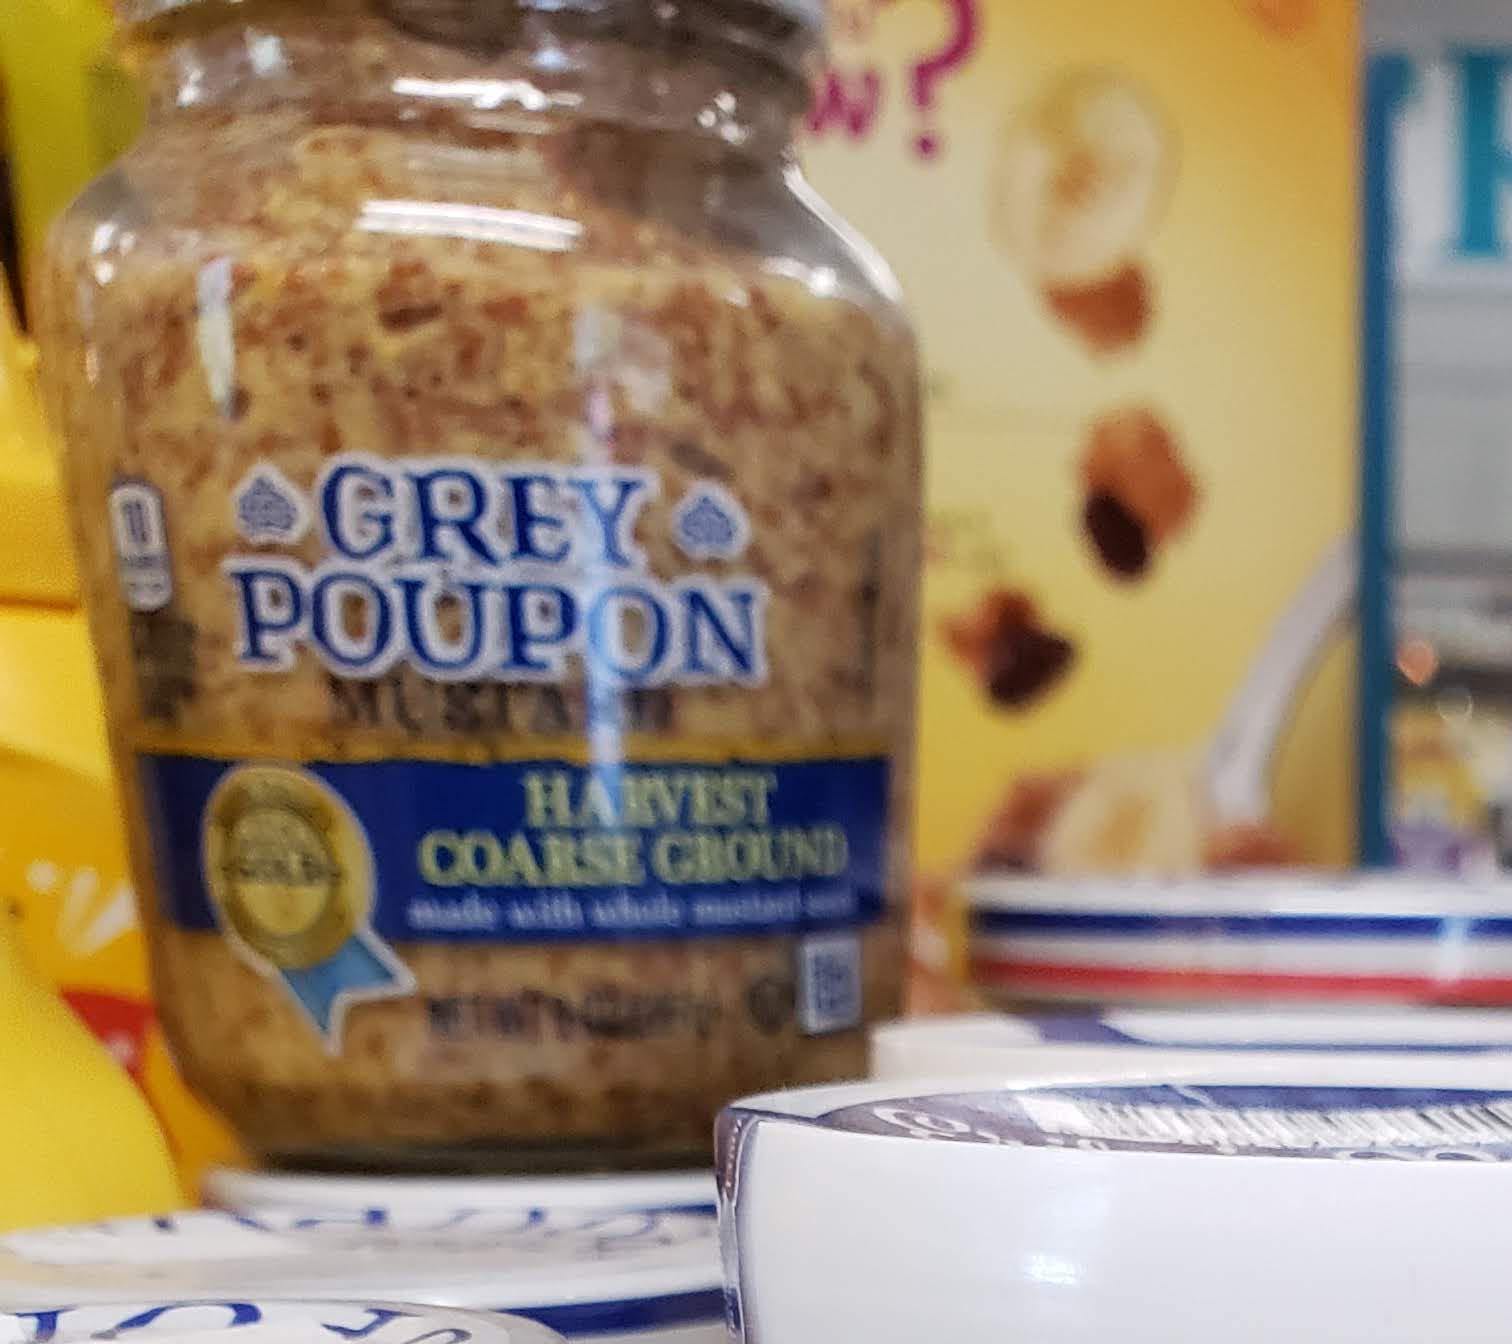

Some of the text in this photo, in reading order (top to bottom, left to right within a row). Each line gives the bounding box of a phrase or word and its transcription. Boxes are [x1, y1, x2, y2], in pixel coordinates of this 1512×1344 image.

[320, 463, 644, 570] GREY
[230, 568, 756, 682] POUPON
[523, 766, 777, 830] HARVEST
[416, 827, 647, 888] COARSE
[652, 822, 851, 886] GROUND
